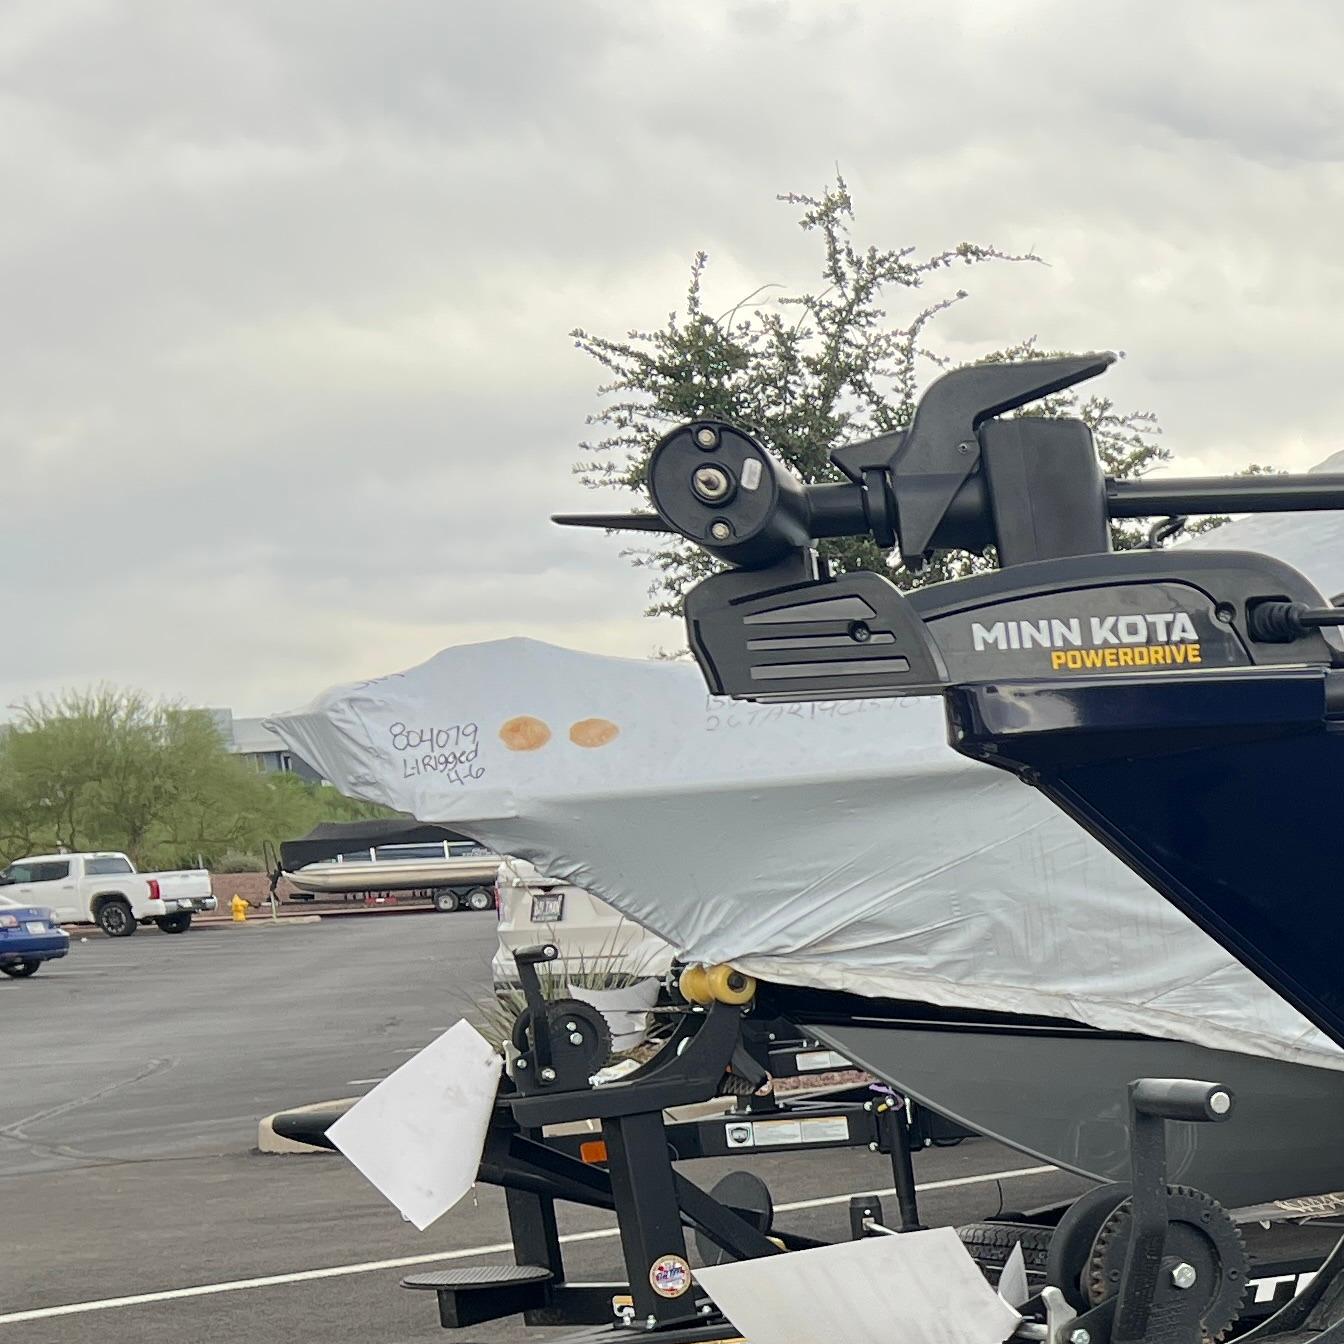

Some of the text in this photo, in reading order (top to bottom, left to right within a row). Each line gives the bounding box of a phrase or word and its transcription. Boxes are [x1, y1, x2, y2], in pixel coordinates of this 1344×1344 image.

[971, 612, 1199, 651] MINN KOTA
[1051, 643, 1202, 670] POWERDRIVE
[390, 722, 478, 752] 804079
